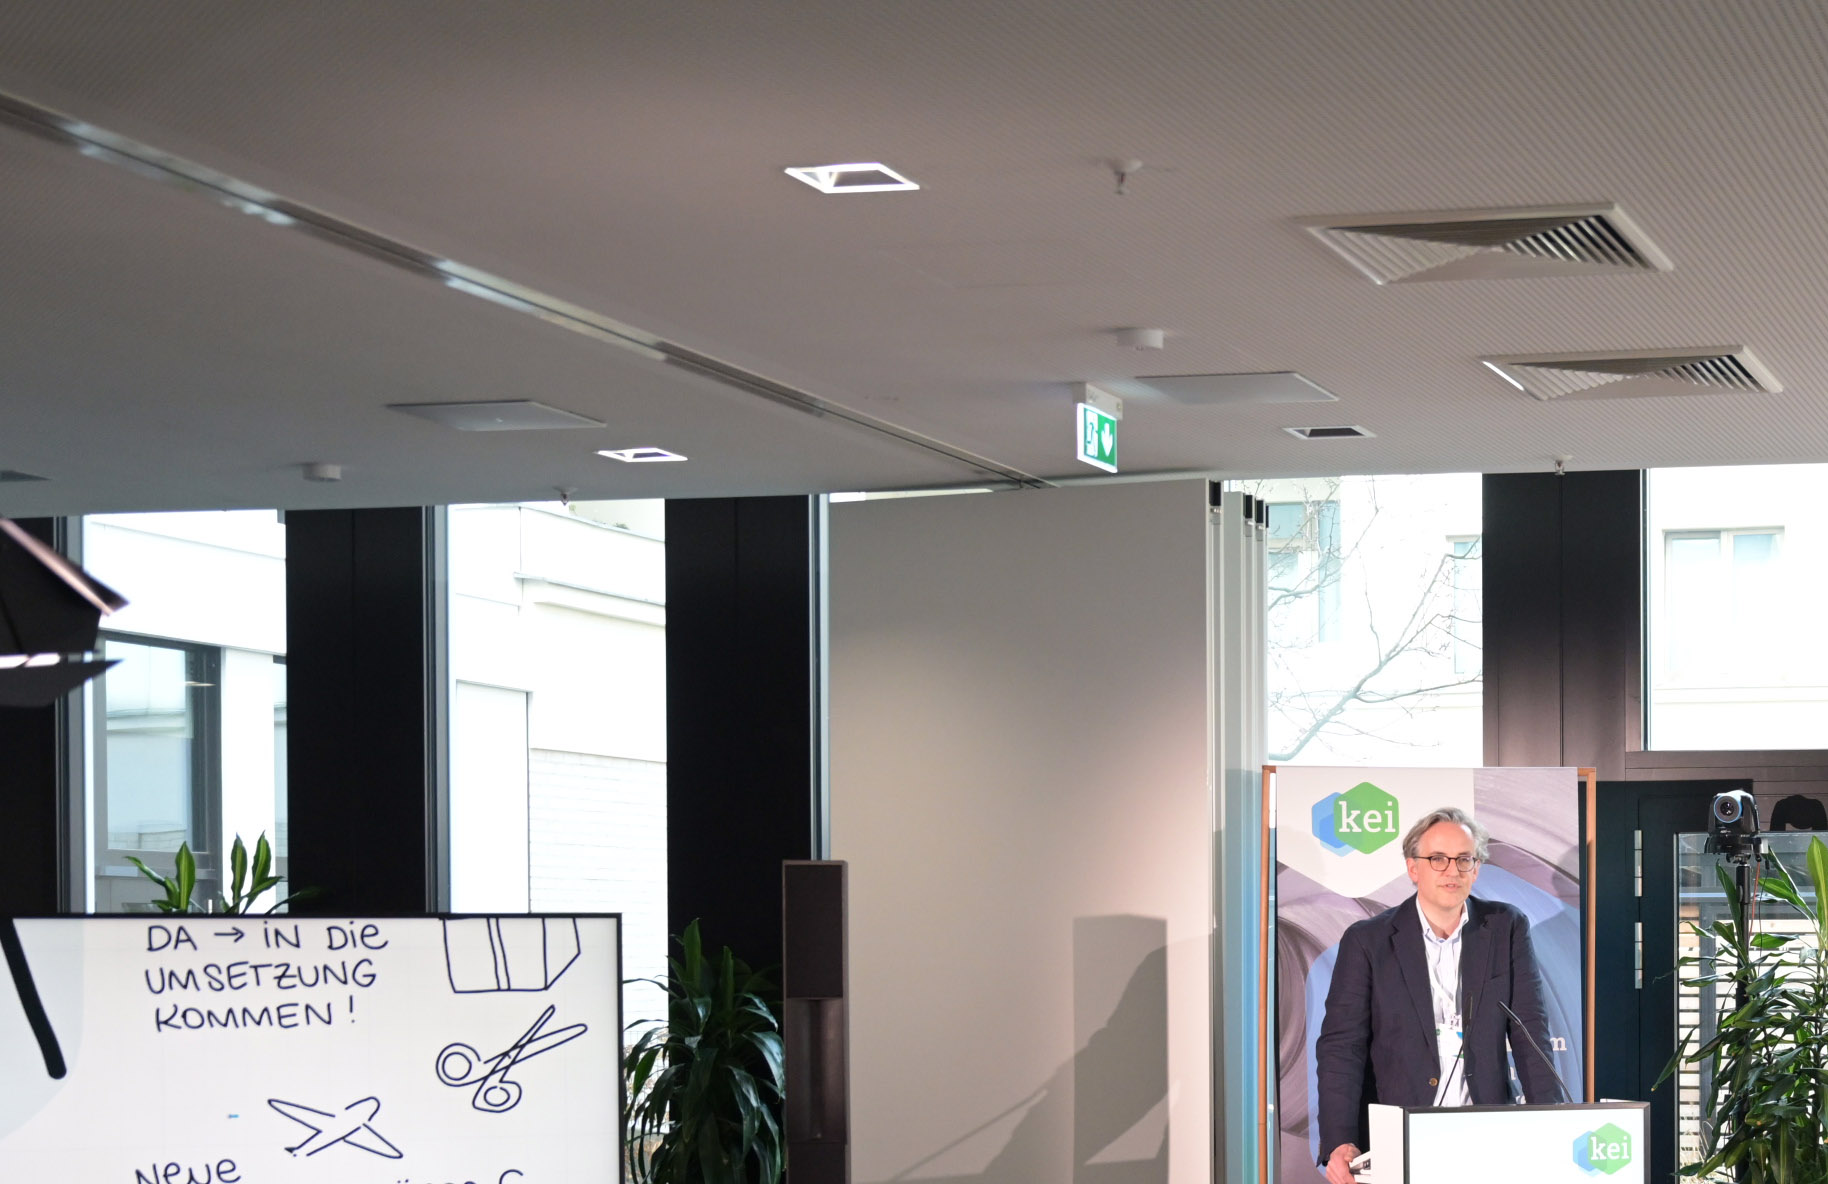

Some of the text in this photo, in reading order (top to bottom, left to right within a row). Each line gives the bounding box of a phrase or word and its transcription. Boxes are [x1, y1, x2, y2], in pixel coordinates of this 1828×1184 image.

[1338, 801, 1396, 833] kei
[147, 925, 197, 952] DA
[145, 959, 376, 993] UMSETZUNG
[1590, 1137, 1629, 1160] kei
